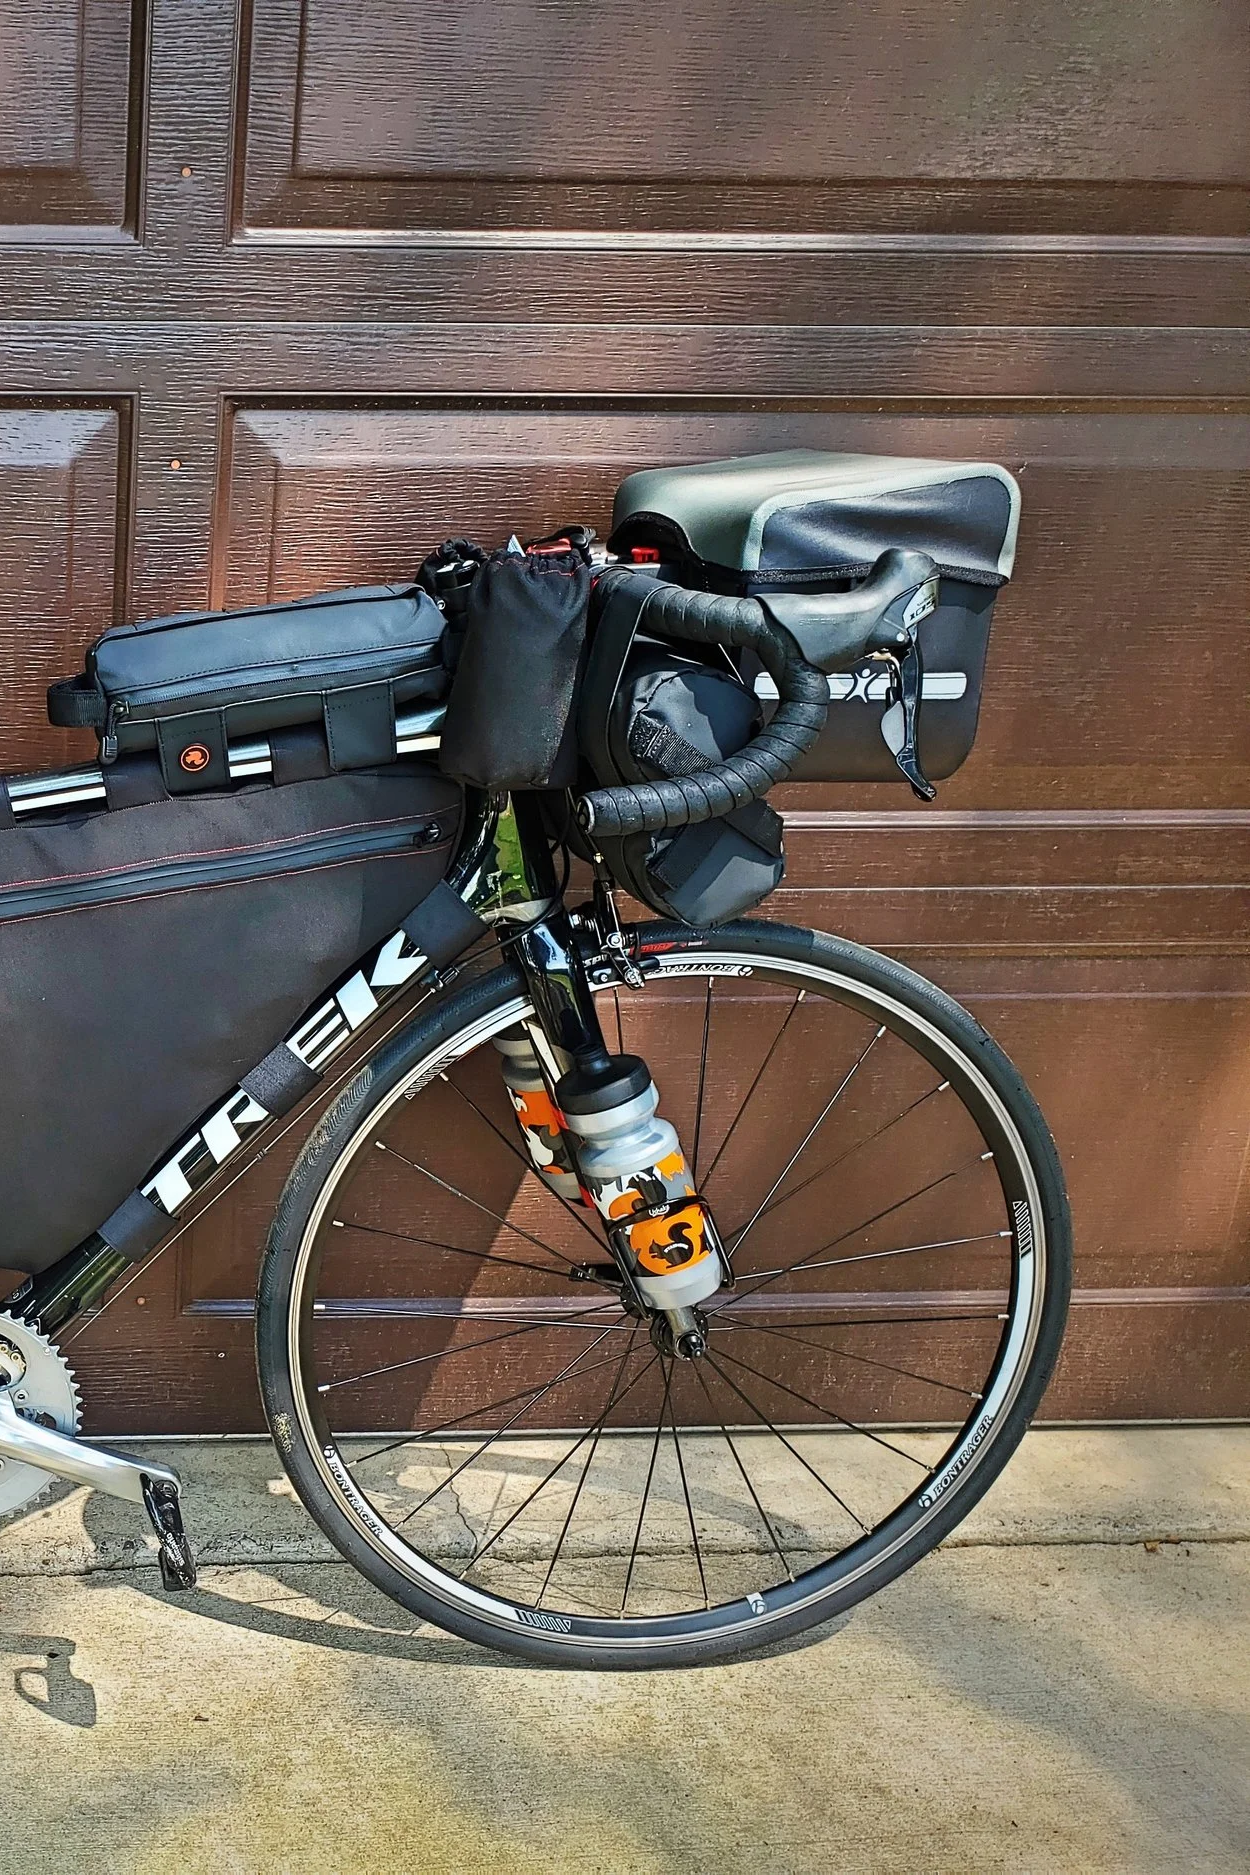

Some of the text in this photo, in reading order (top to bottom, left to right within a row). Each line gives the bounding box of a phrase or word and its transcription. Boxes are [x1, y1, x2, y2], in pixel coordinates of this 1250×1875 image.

[140, 929, 428, 1214] TREK
[933, 1415, 994, 1499] BONTRAGER
[330, 1462, 384, 1538] BONTRAGER
